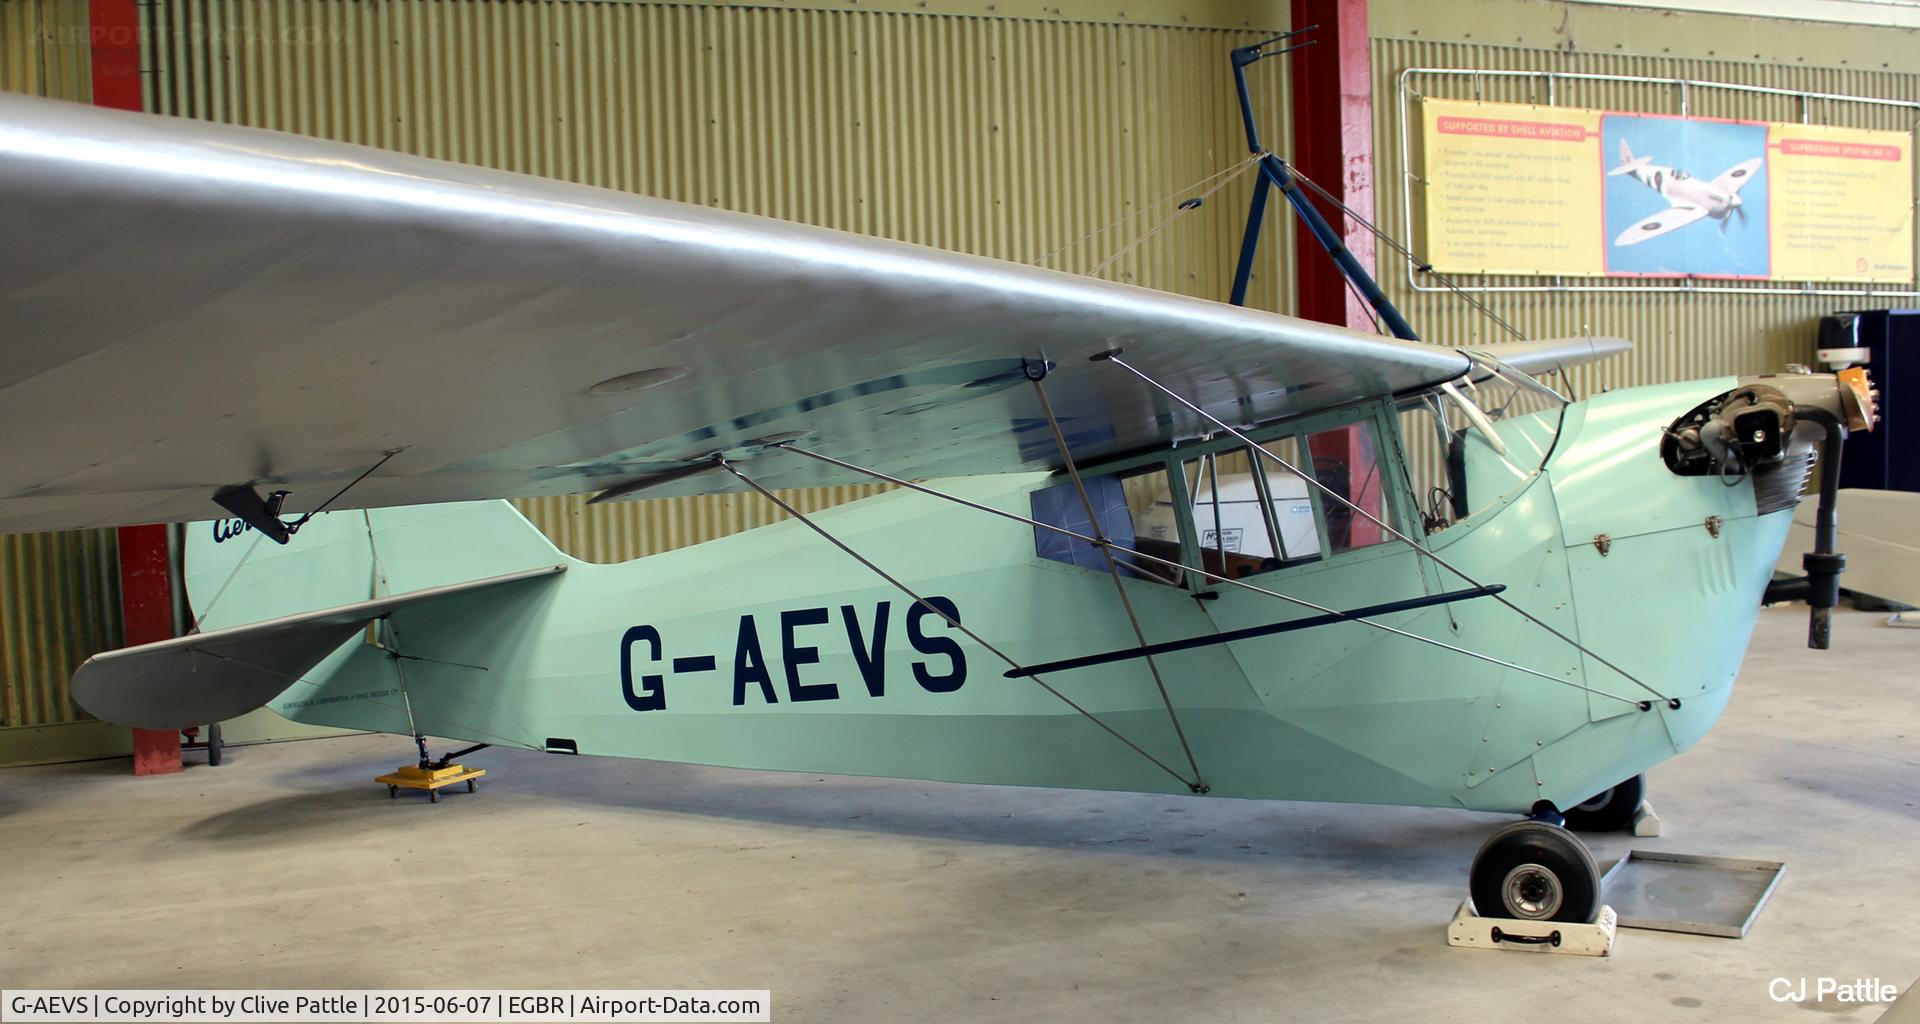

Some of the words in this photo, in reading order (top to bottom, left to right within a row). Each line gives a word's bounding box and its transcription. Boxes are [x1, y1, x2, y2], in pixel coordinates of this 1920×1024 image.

[1443, 120, 1496, 132] SUPPORTED
[1498, 125, 1508, 133] BY
[1510, 125, 1537, 135] SHELL
[1539, 127, 1581, 137] AVIATION
[620, 596, 967, 712] G-AEVS
